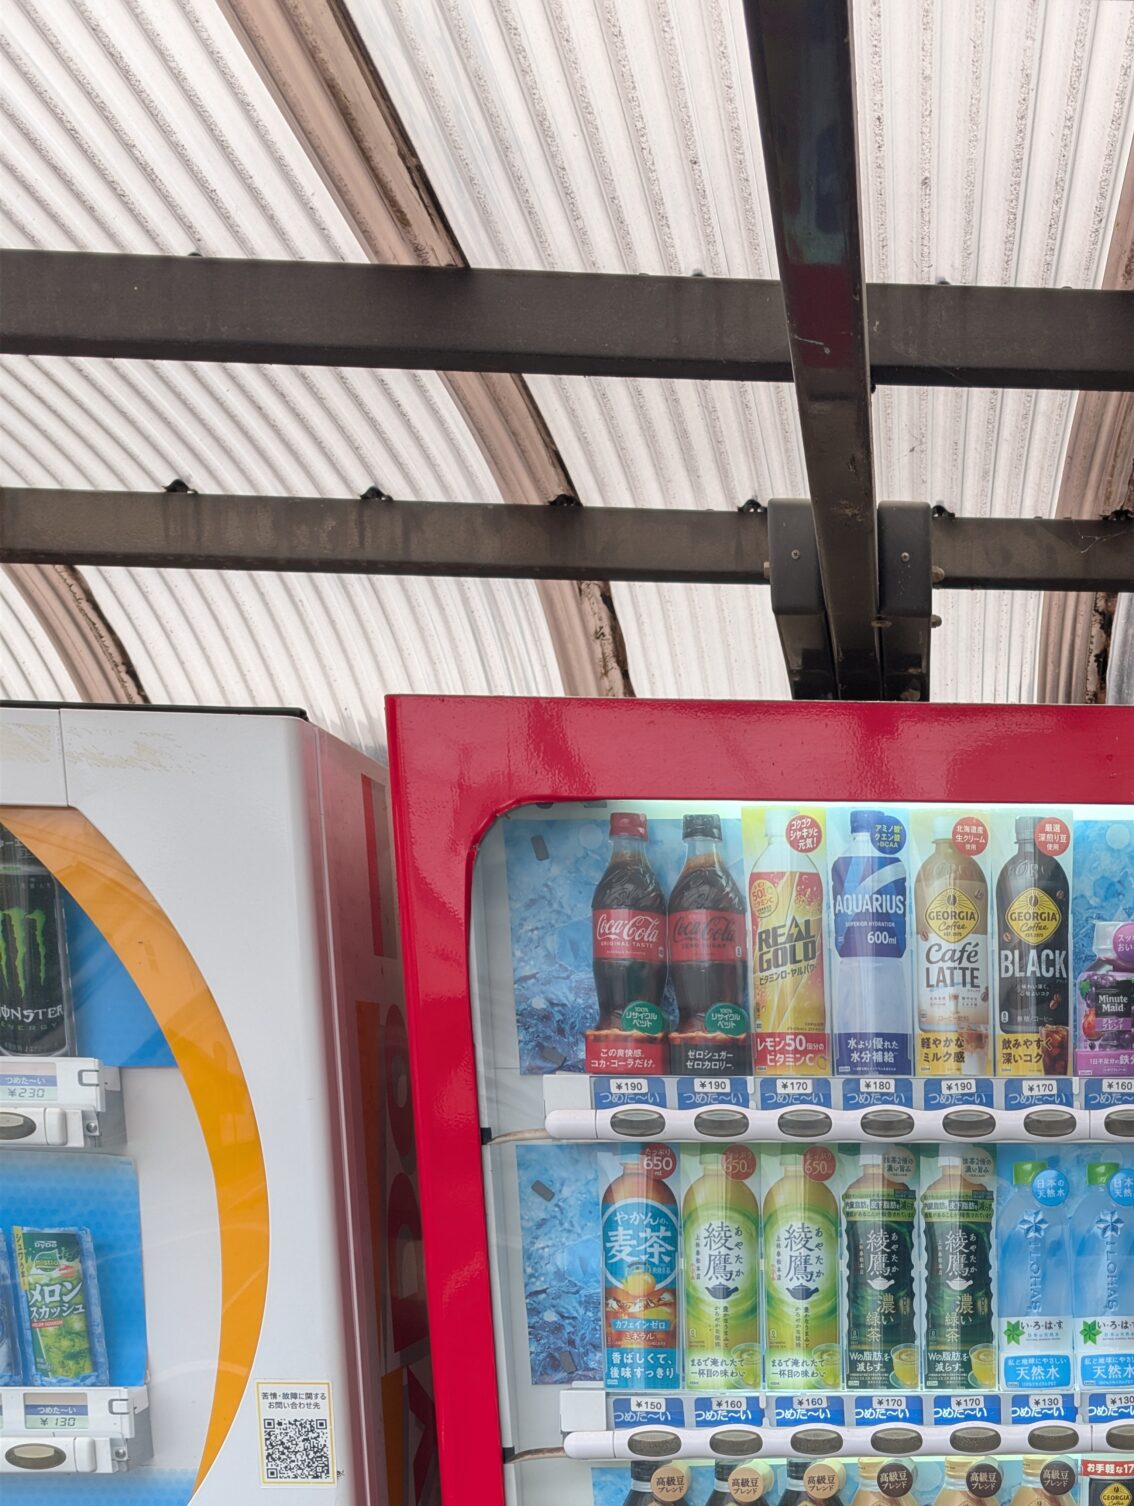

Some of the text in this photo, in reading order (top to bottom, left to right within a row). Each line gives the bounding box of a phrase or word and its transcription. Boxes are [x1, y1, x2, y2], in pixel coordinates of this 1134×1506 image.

[956, 825, 983, 834] 北海道産
[1044, 824, 1061, 833] 厳選
[955, 834, 985, 843] 生クリーム
[1038, 833, 1067, 843] 深煎り豆
[835, 894, 905, 915] AQUARIUS
[928, 910, 976, 922] GEORGIA
[1010, 911, 1057, 922] GEORGIA
[597, 914, 660, 942] Coca-Cola
[758, 916, 816, 946] REAL
[938, 921, 967, 932] Coffee
[867, 930, 897, 945] 600ml
[758, 942, 816, 973] GOLD
[925, 943, 979, 965] Café
[1000, 949, 1068, 979] BLACK
[925, 966, 980, 989] LATTE
[1098, 994, 1128, 1004] Minute
[0, 1004, 64, 1023] ONSTER
[1102, 1003, 1124, 1013] Maid
[626, 1012, 658, 1020] リサイクル
[848, 1037, 899, 1050] 水より優れた
[921, 1036, 965, 1049] 軽やかな
[1002, 1037, 1053, 1050] 飲みやすく
[688, 1049, 734, 1060] ゼロシュガー
[766, 1052, 815, 1067] ビタミンC
[850, 1051, 895, 1063] 水分補給
[922, 1051, 965, 1064] ミルク感
[1002, 1052, 1044, 1065] 深いコク
[616, 1082, 643, 1091] ¥190
[699, 1080, 727, 1090] ¥190
[781, 1082, 808, 1091] ¥170
[864, 1081, 891, 1090] ¥180
[1027, 1083, 1053, 1092] ¥170
[1107, 1082, 1133, 1091] ¥160
[8, 1088, 45, 1098] ¥230
[643, 1156, 673, 1171] 650
[1037, 1178, 1064, 1189] 日本の
[606, 1226, 676, 1264] 麦茶
[703, 1222, 734, 1282] 綾鷹
[734, 1227, 745, 1278] あやたか
[784, 1223, 814, 1282] 綾鷹
[30, 1281, 83, 1306] メロン
[30, 1303, 86, 1320] スカッシュ
[615, 1319, 666, 1330] カフェインゼロ
[611, 1353, 672, 1365] 香ばしくて、
[610, 1367, 674, 1380] 後味すっきり
[690, 1368, 746, 1378] 一杯目の味わい
[1016, 1364, 1061, 1381] 天然水
[261, 1392, 327, 1401] 苦情・故障に関する
[1034, 1396, 1059, 1406] ¥130
[1110, 1395, 1134, 1405] ¥130
[716, 1400, 742, 1409] ¥160
[656, 1475, 685, 1486] 高級豆
[658, 1485, 684, 1493] ブレンド
